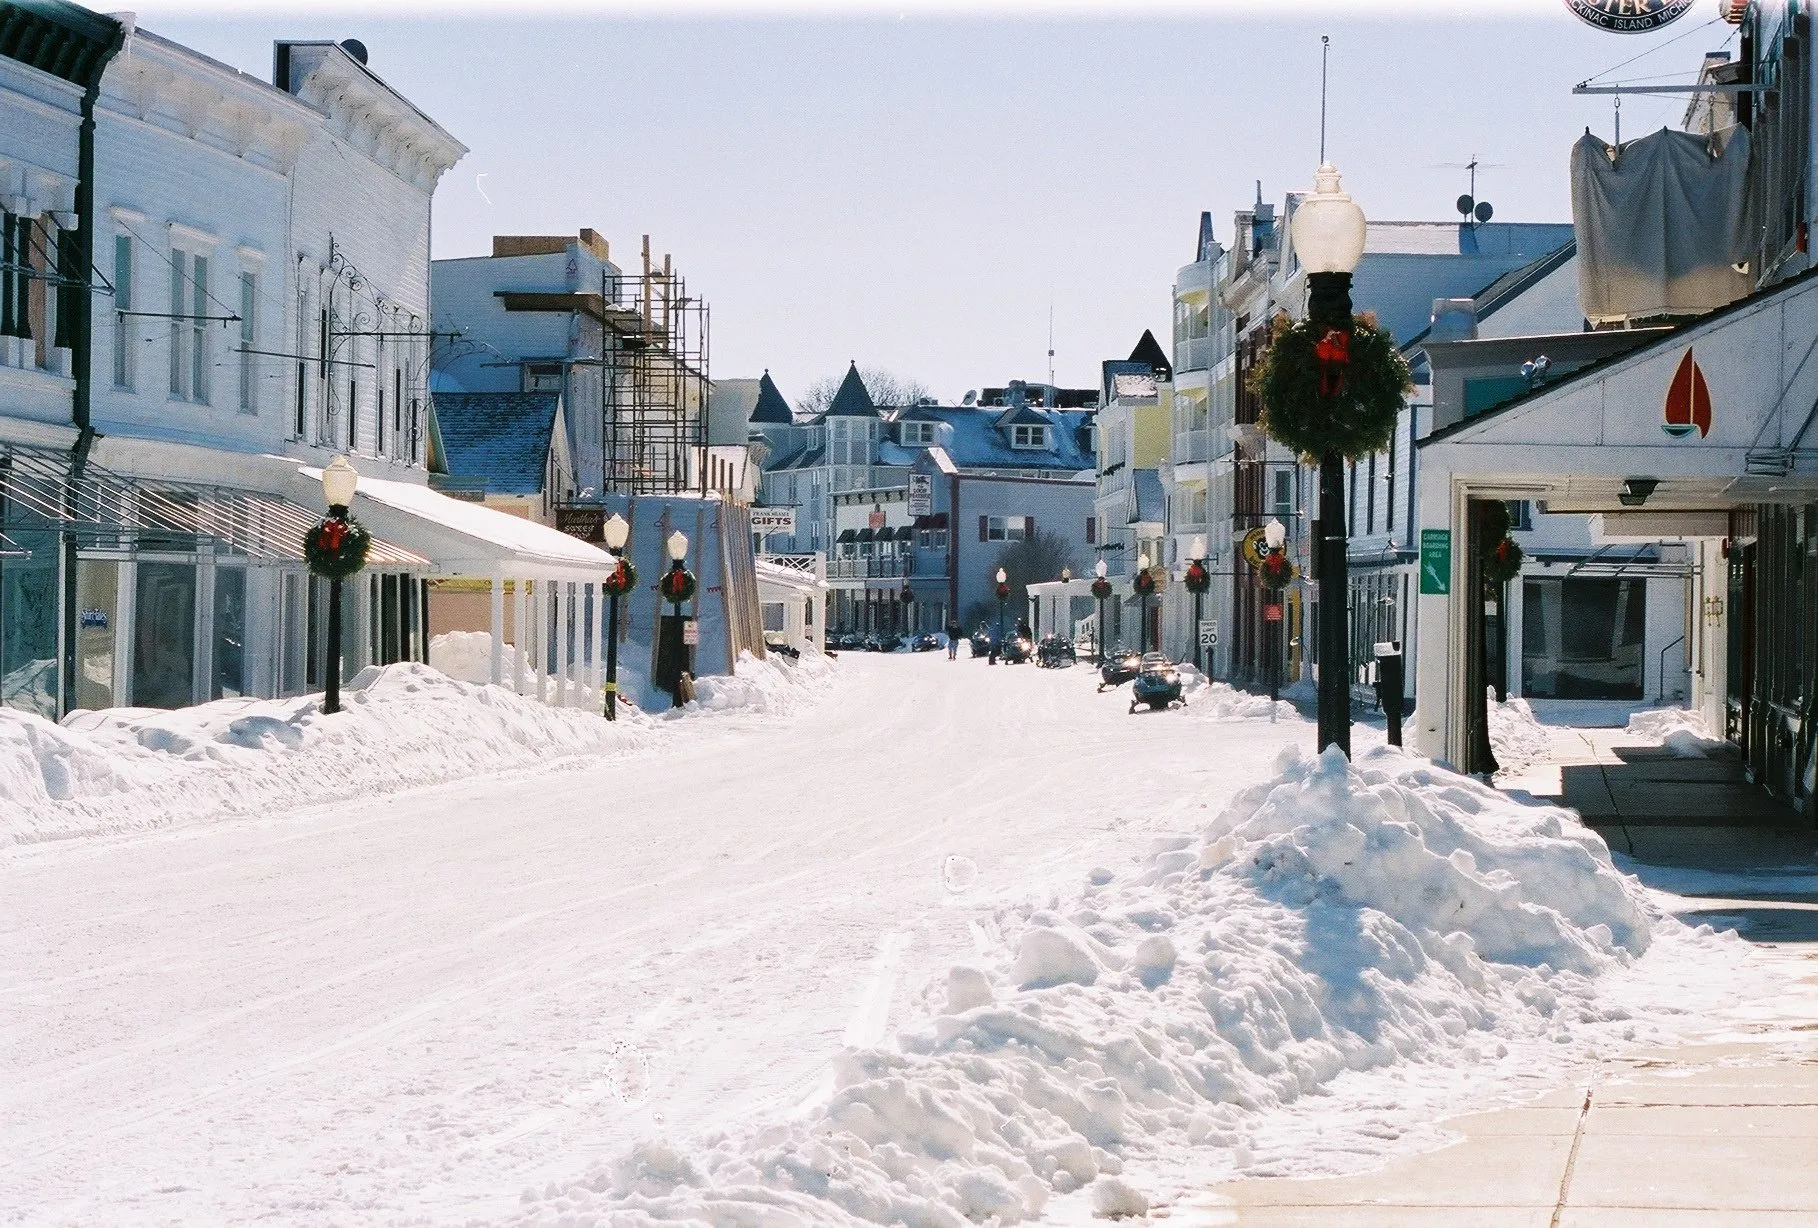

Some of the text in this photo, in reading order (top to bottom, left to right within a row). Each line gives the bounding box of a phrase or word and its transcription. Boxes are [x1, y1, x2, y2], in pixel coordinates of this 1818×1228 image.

[1570, 0, 1609, 25] CKINAC
[1614, 18, 1653, 29] ISLAND
[751, 516, 792, 525] GIFTS
[1201, 633, 1217, 644] 20
